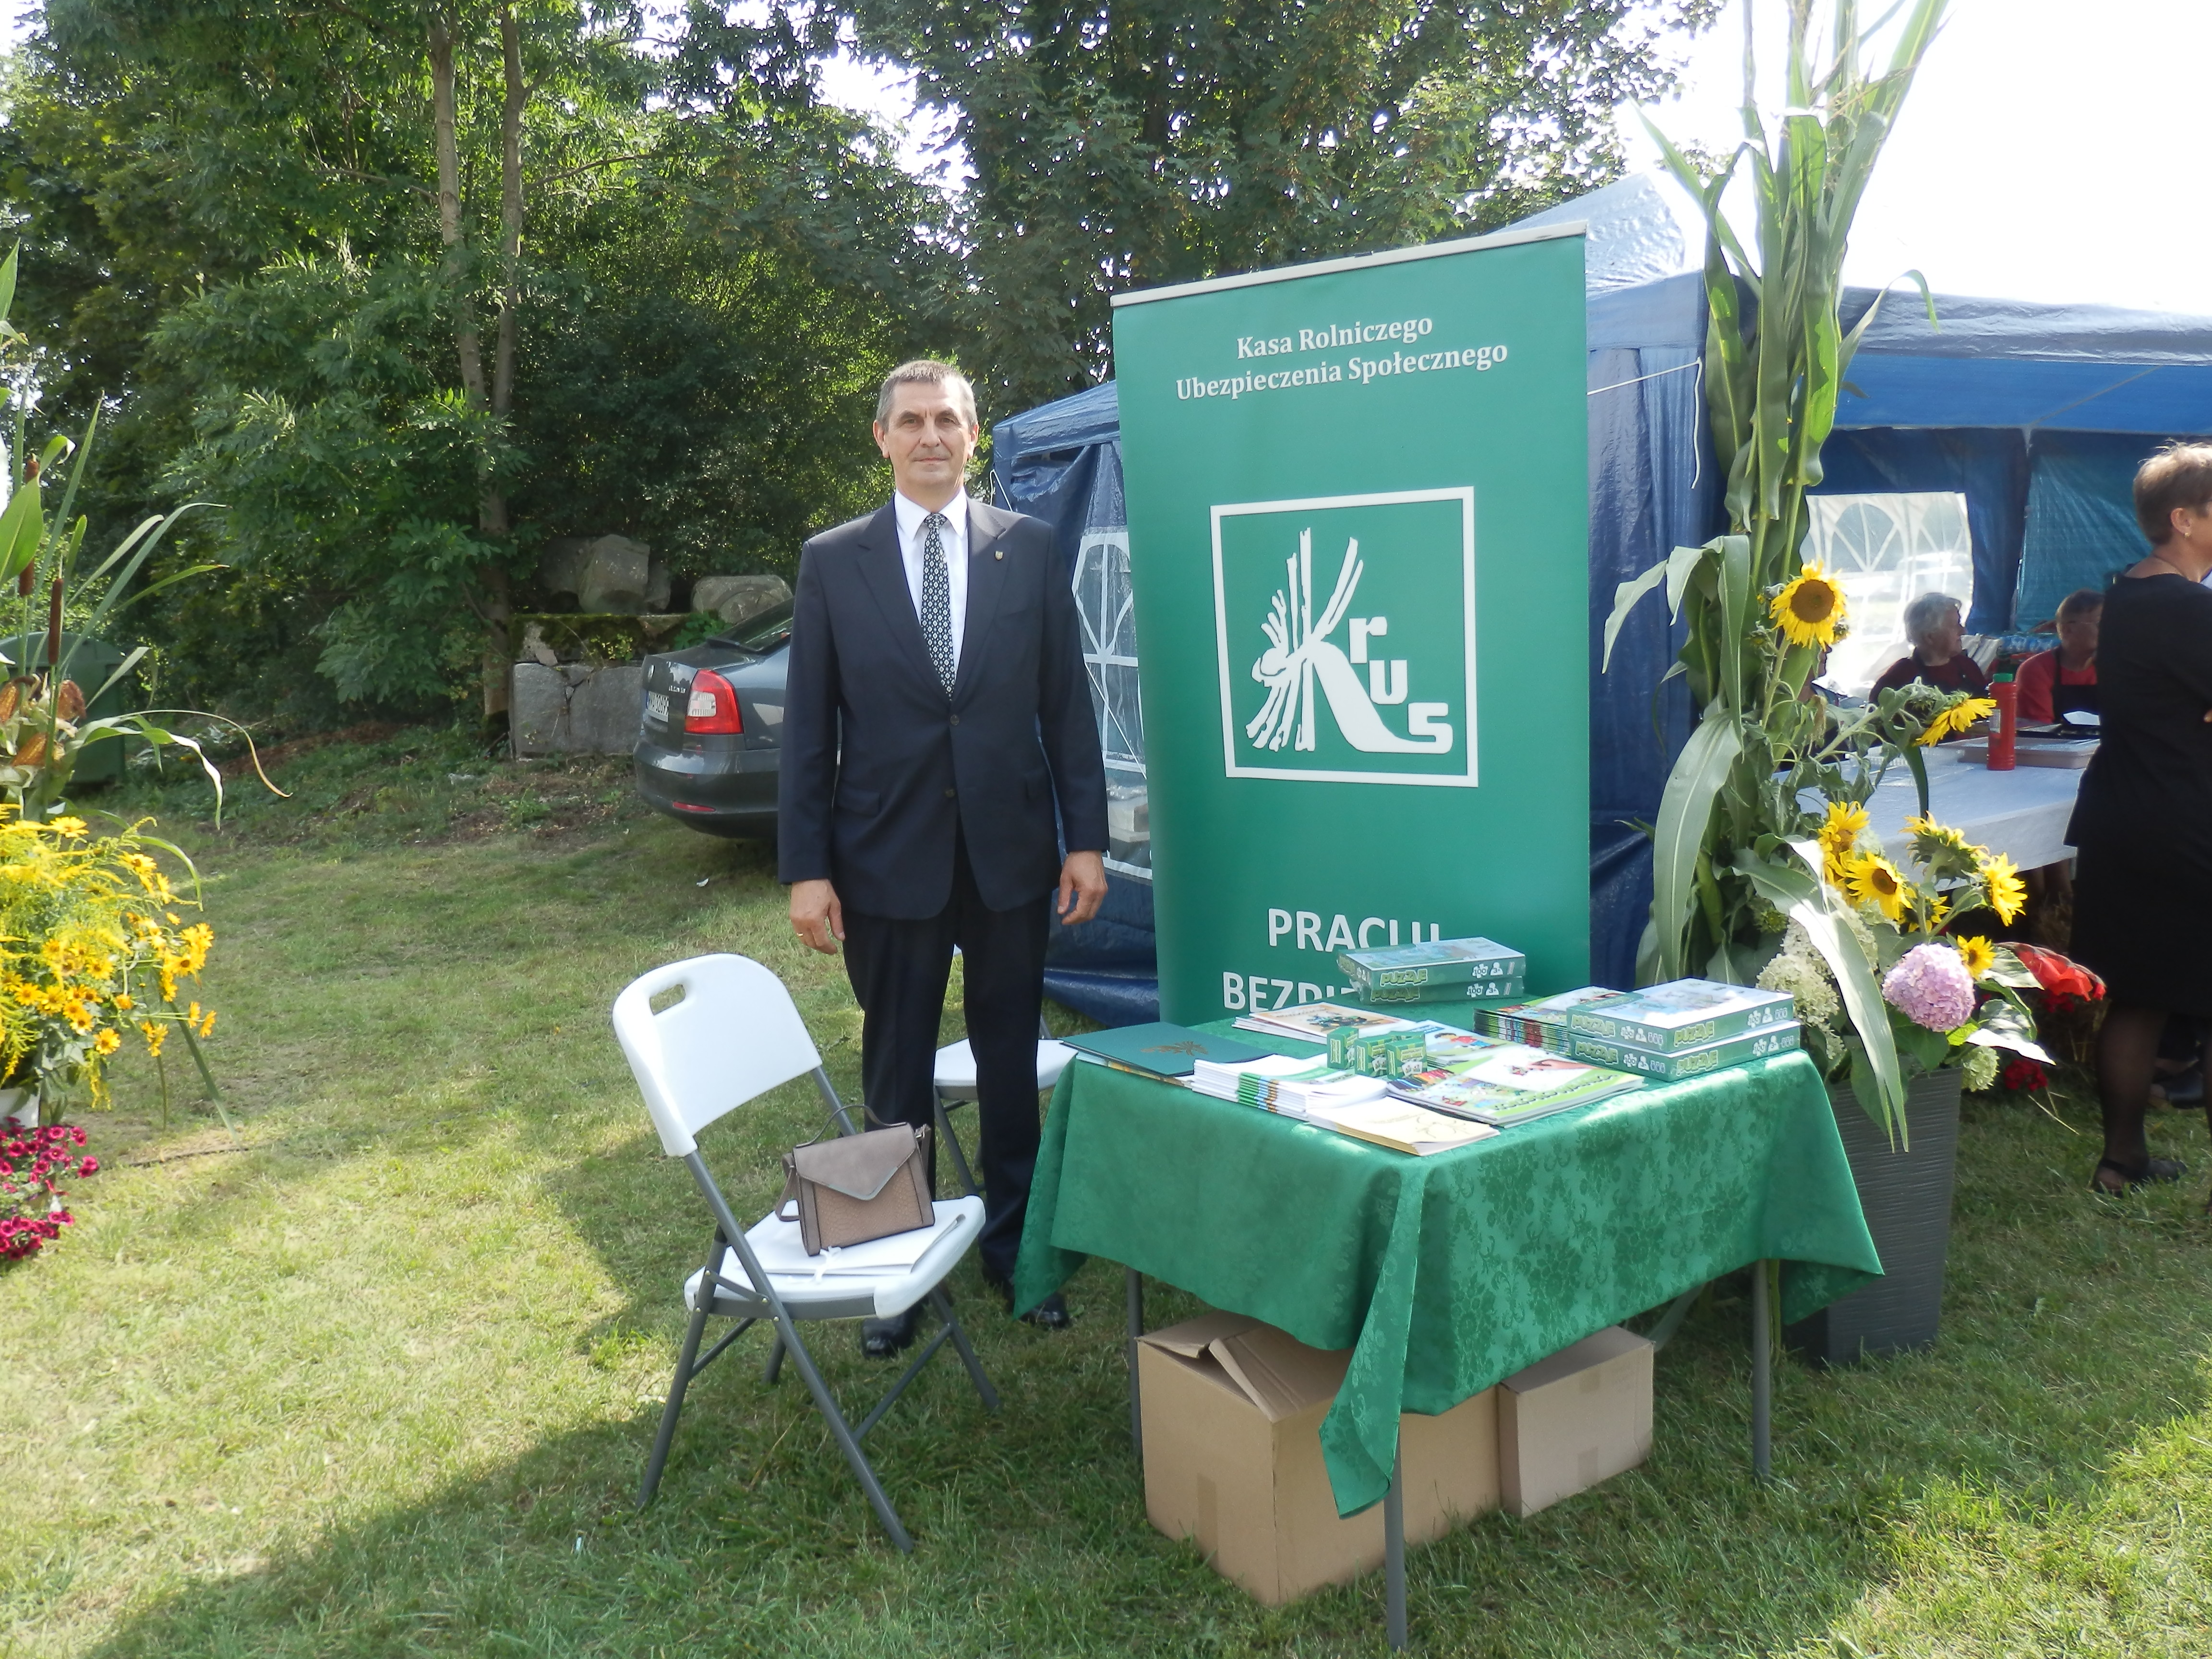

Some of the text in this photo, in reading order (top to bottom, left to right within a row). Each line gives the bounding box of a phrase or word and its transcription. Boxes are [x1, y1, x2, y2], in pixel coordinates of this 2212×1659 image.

[1237, 317, 1433, 360] Kasa Rolniczego
[1176, 345, 1508, 400] Ubezpieczenia Społecznego
[1380, 968, 1428, 987] PUZZLE
[1370, 987, 1420, 1002] PUZZLE
[1571, 1014, 1615, 1038] PUZZLE
[1674, 1021, 1714, 1047] PUZZLE
[1575, 1041, 1618, 1065] PUZZLE
[1676, 1050, 1718, 1076] PUZZLE
